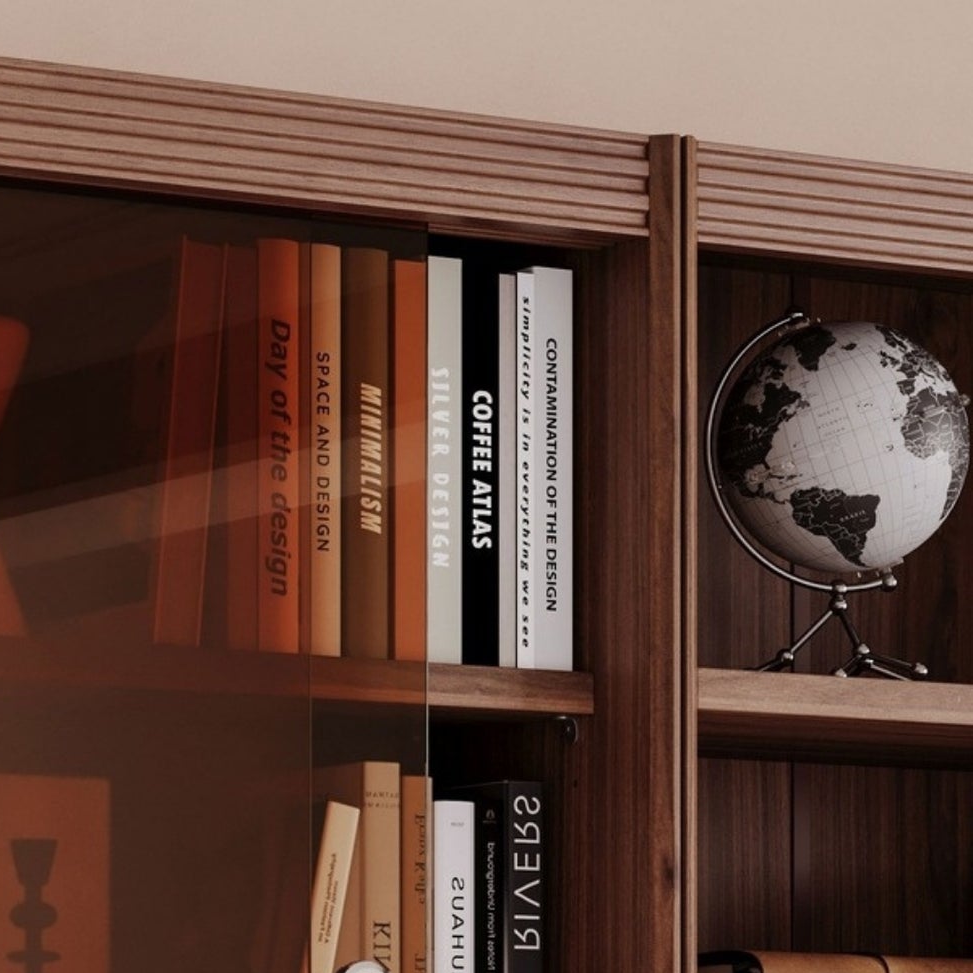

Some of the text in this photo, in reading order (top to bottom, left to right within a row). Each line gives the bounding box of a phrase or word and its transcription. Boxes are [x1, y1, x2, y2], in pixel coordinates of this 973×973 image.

[265, 318, 291, 596] Day of the design
[316, 352, 330, 552] SPACE AND DESIGN
[360, 383, 382, 534] MINIMALISM
[431, 367, 450, 568] SILVER DESIGN
[472, 390, 493, 550] COFFEE ATLAS
[520, 296, 532, 648] simplicity is in everything we see
[546, 338, 558, 611] CONTAMINATION OF THE DESIGN
